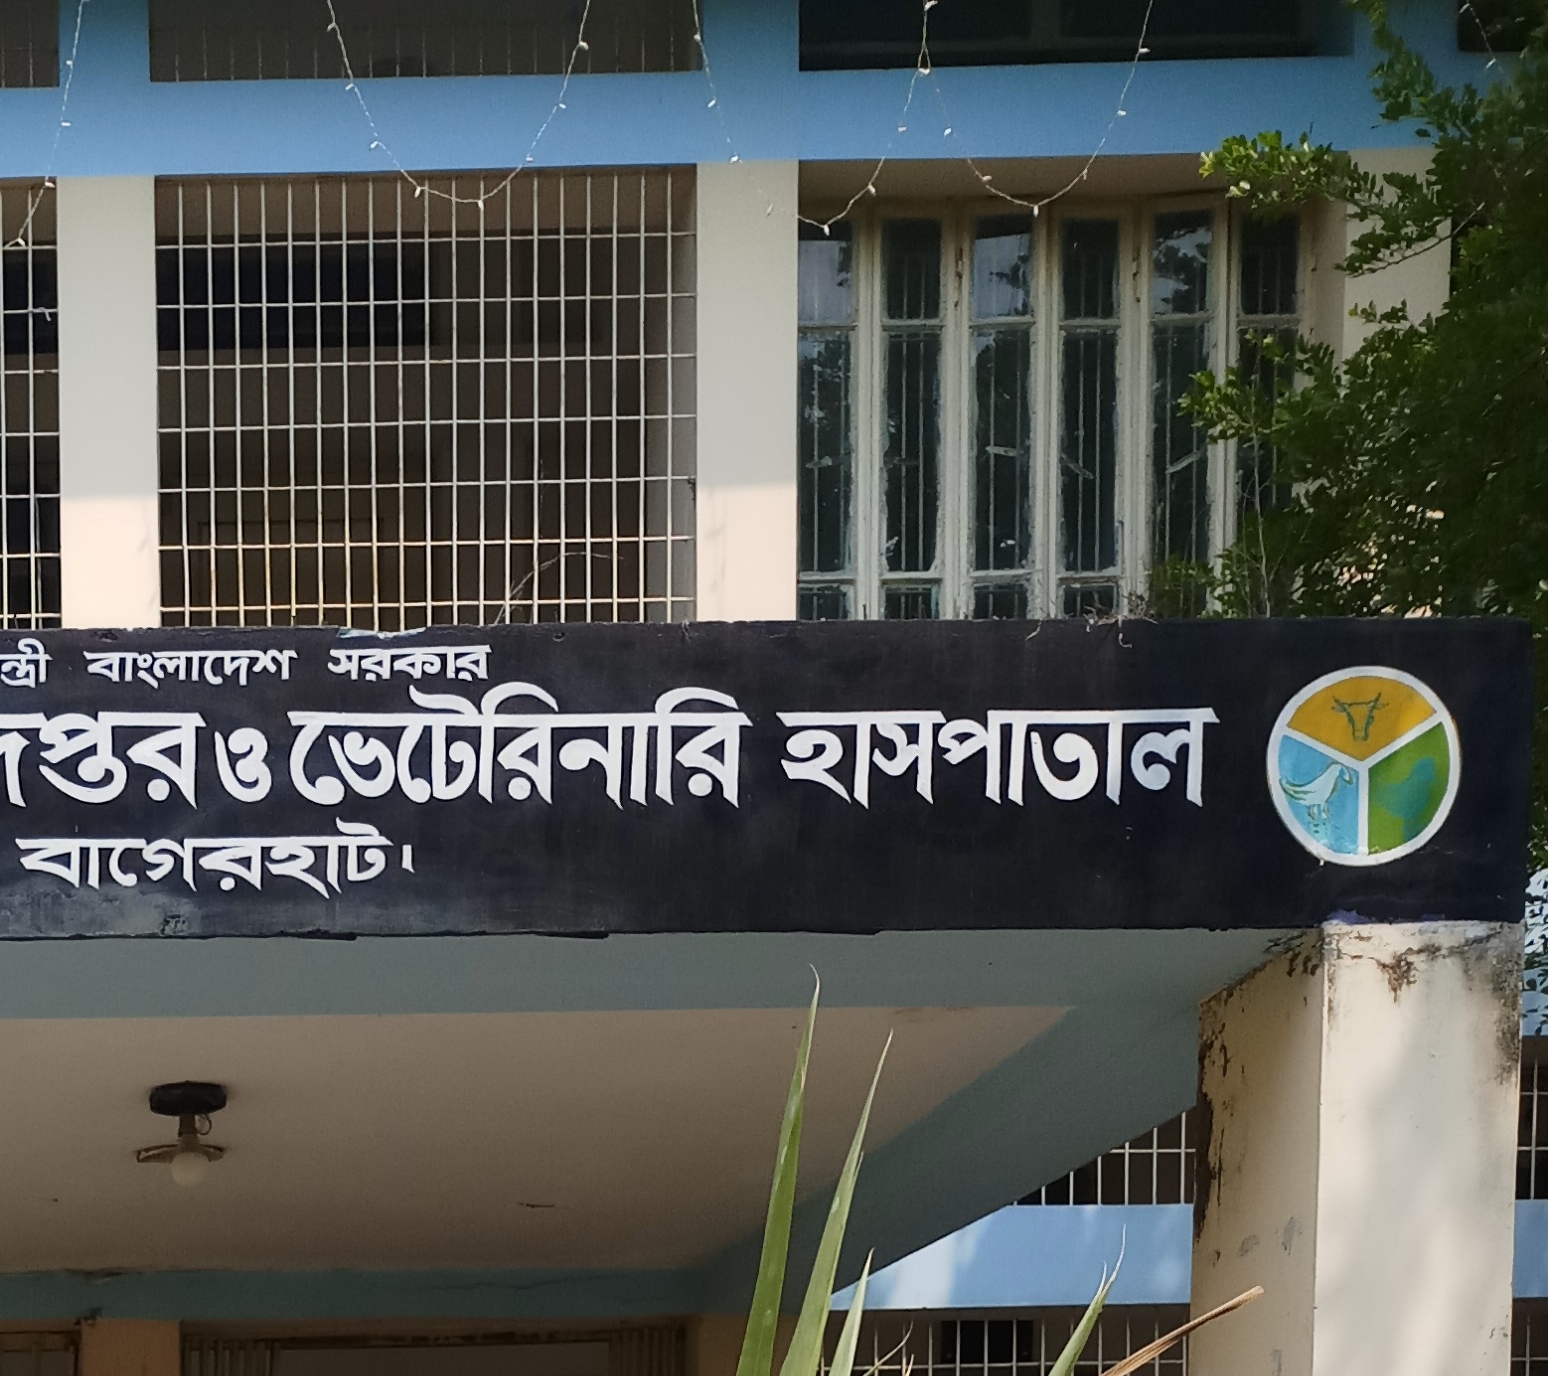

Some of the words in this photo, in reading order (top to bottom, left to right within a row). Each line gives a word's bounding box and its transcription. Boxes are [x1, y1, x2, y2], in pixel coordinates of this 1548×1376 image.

[83, 648, 298, 689] বাংলাদেশ
[327, 644, 492, 682] সরকার
[214, 727, 272, 803] ও
[287, 681, 754, 809] ভেটেরিনারি
[775, 707, 1220, 810] হাসপাতাল
[15, 816, 415, 899] বাগেরহাট।
